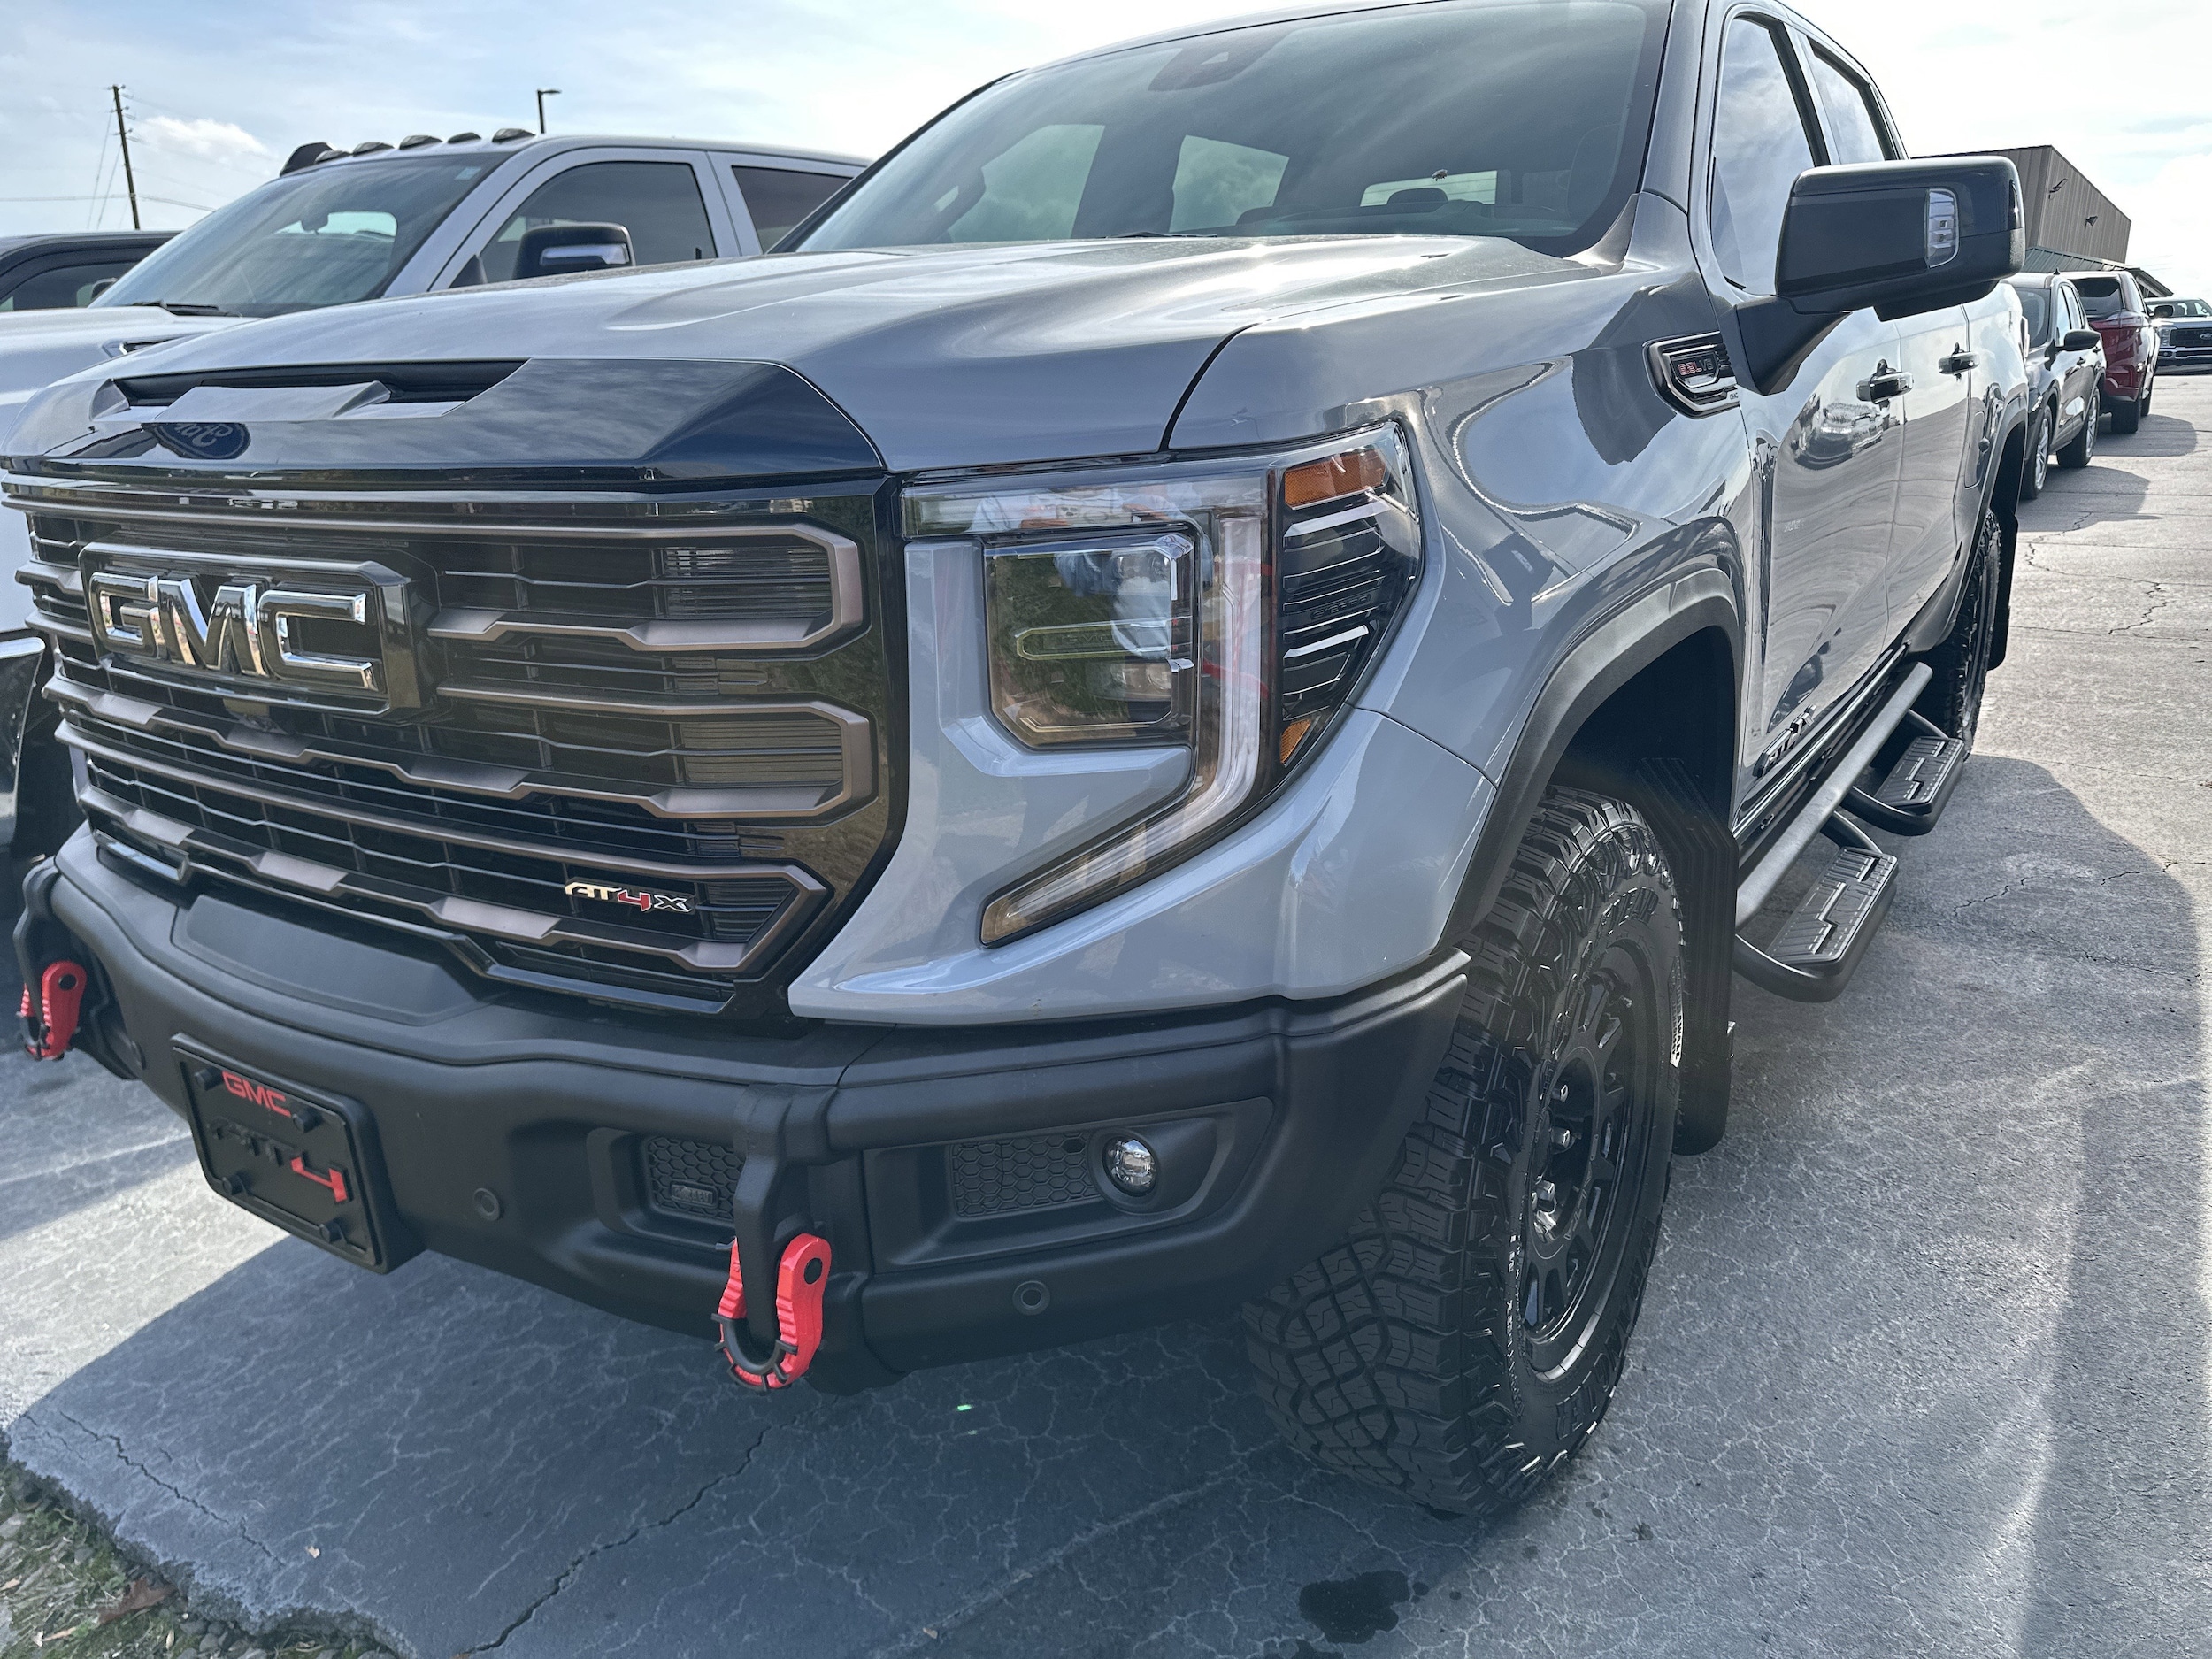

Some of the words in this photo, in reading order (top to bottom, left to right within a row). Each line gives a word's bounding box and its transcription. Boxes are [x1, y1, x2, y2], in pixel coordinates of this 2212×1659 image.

[89, 572, 379, 691] GMC
[565, 882, 692, 912] AT4X
[222, 1070, 291, 1118] GMC
